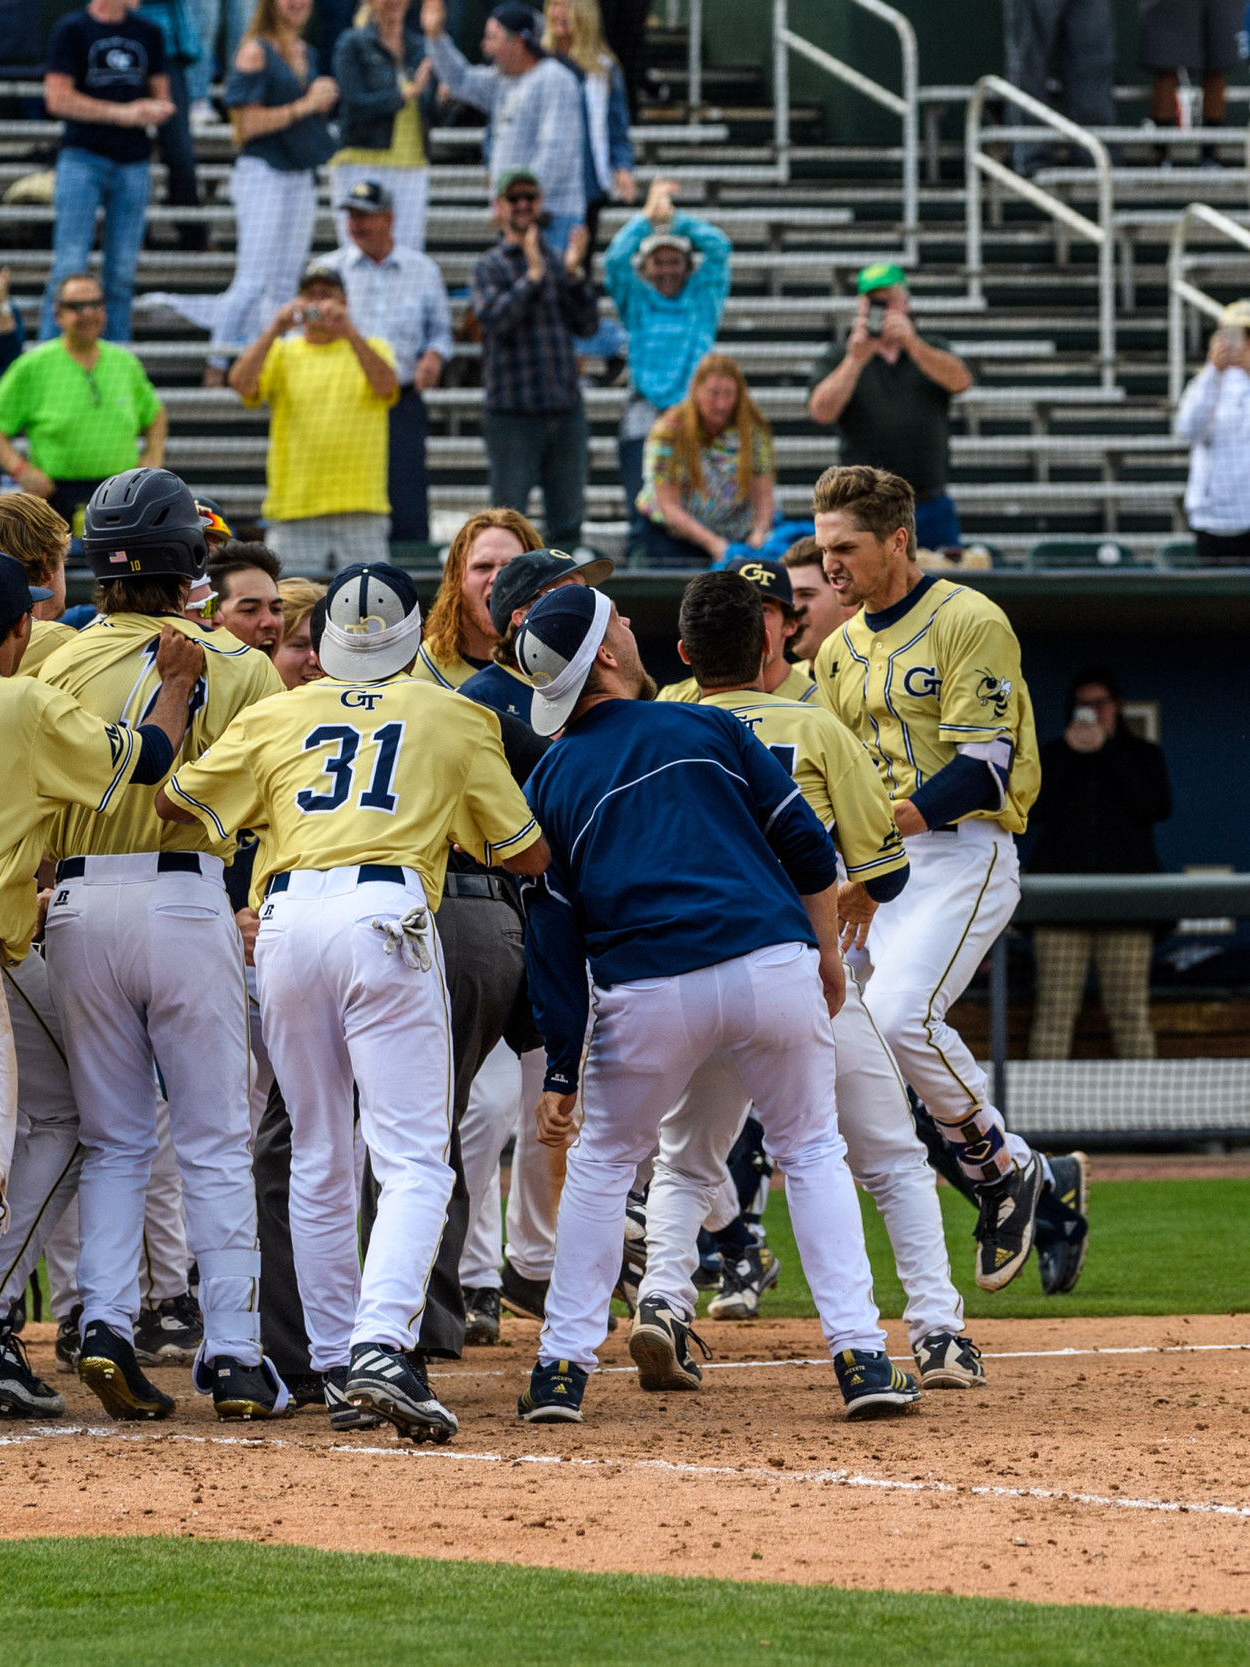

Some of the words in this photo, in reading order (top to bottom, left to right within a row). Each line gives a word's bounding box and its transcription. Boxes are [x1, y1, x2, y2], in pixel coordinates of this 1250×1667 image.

[130, 559, 141, 571] 10
[738, 563, 776, 587] GT
[340, 690, 384, 711] GT
[294, 720, 407, 816] 31
